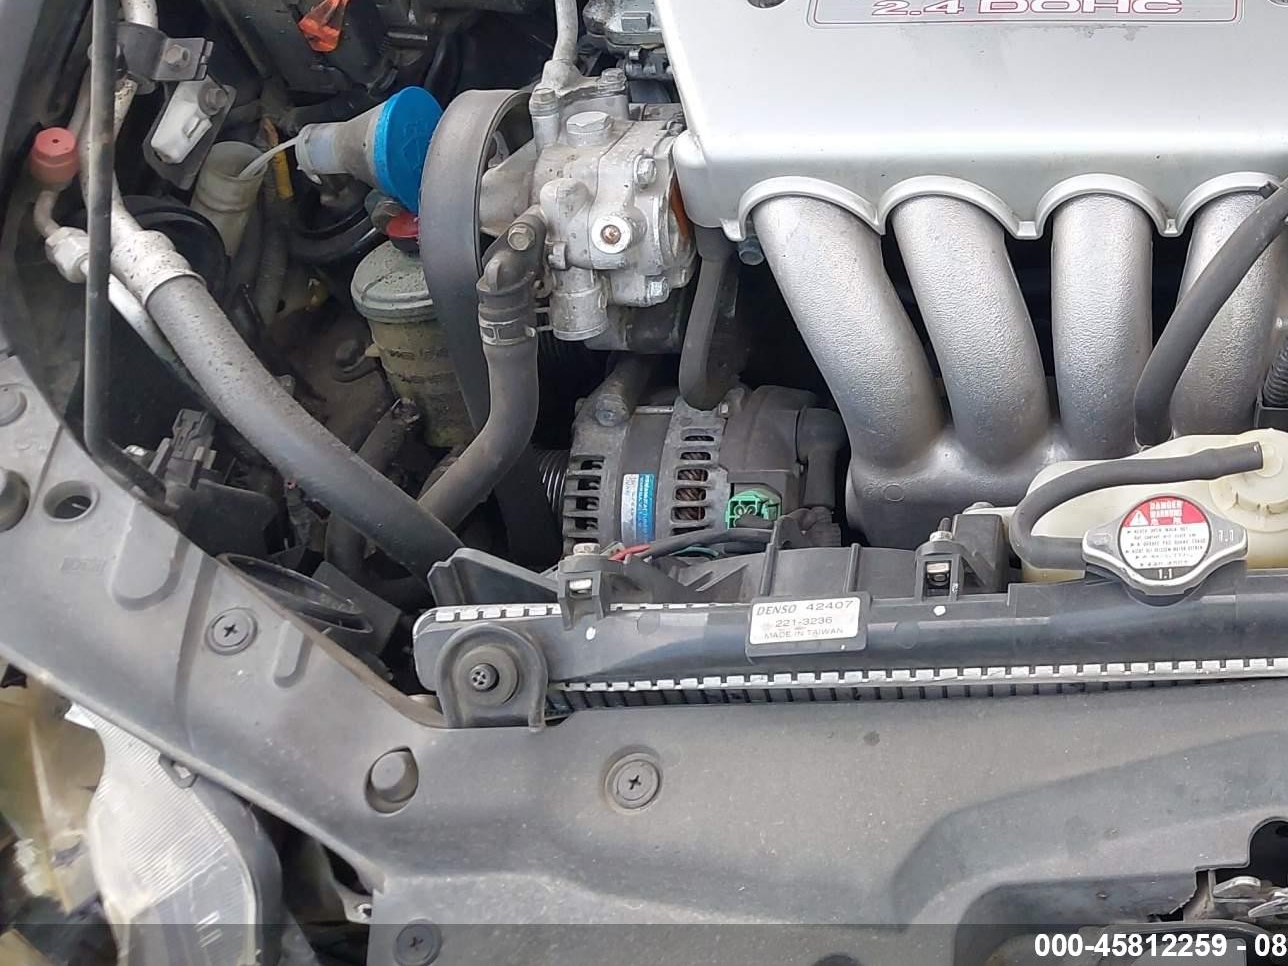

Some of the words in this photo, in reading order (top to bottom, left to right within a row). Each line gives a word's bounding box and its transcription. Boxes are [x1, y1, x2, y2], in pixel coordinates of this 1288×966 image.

[1158, 568, 1173, 580] 1.1
[756, 604, 797, 616] DENSO
[805, 600, 854, 611] 42407
[775, 616, 833, 628] 221-3236
[764, 630, 792, 640] MADE
[807, 628, 844, 638] TAIWAN
